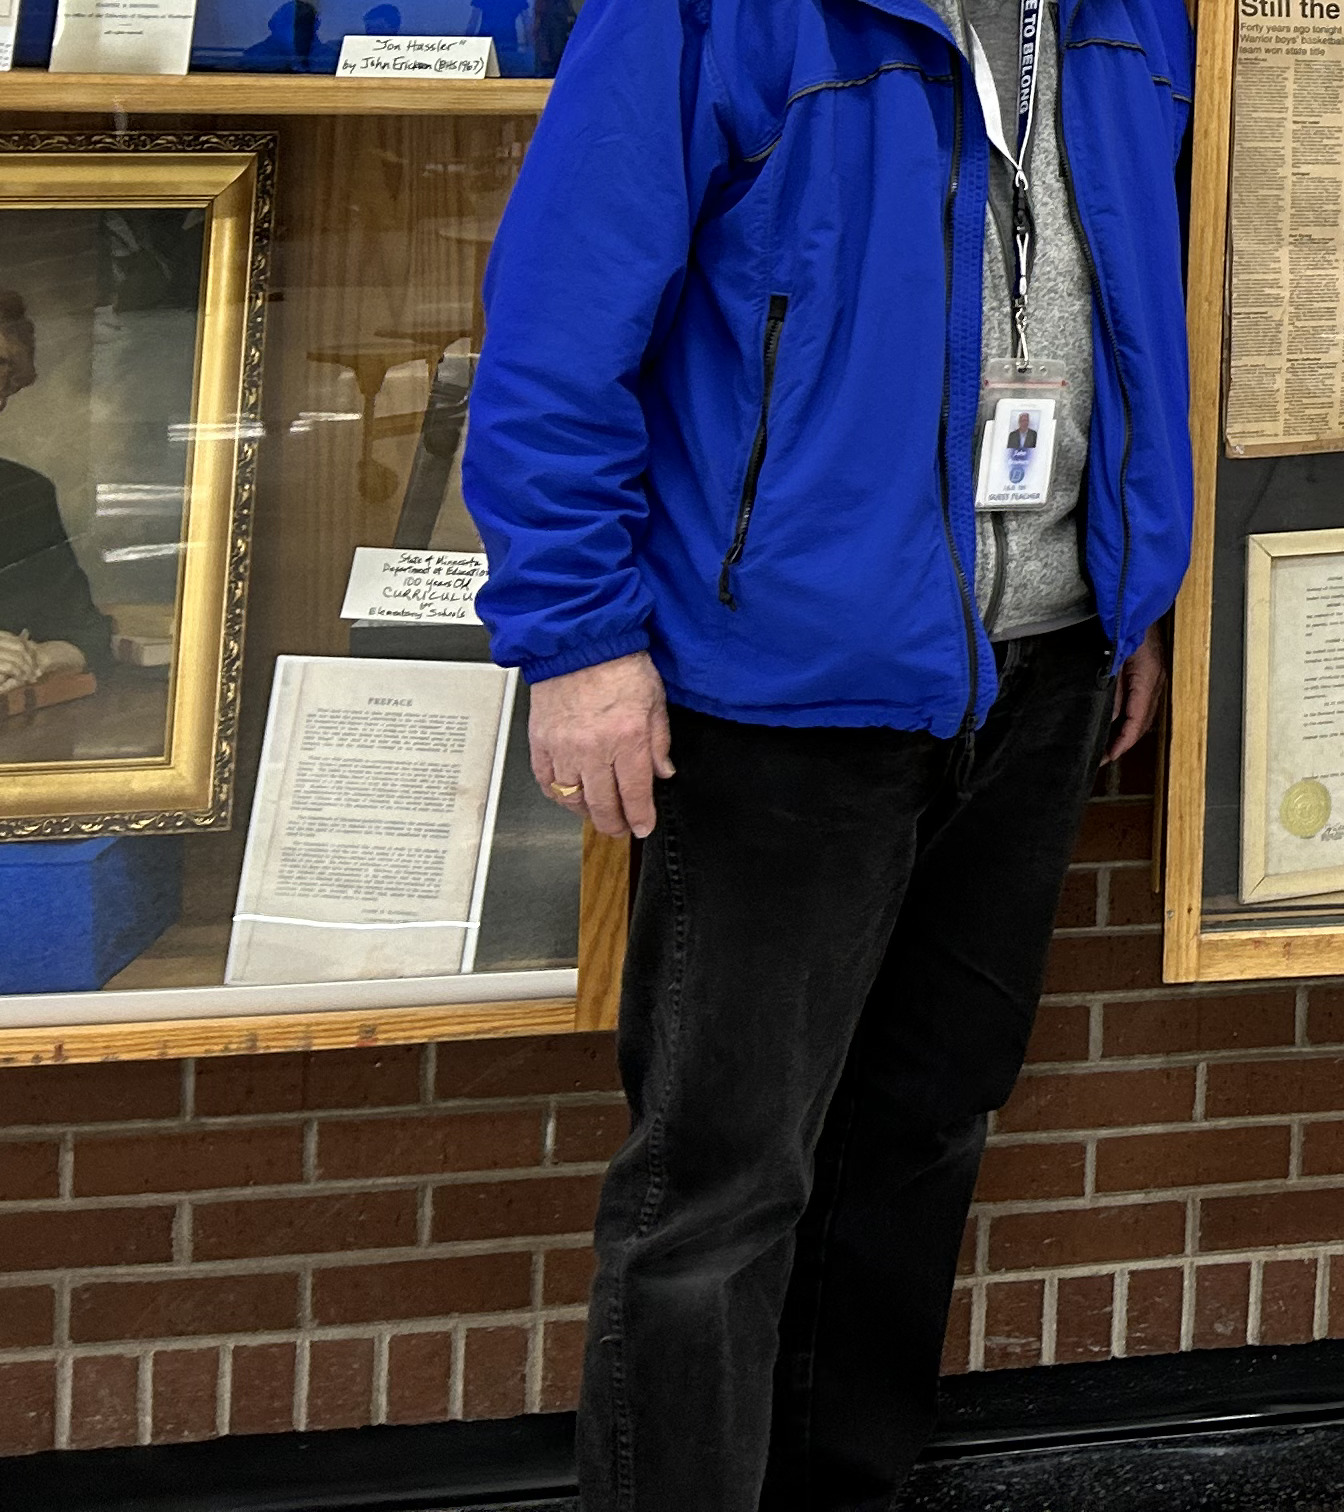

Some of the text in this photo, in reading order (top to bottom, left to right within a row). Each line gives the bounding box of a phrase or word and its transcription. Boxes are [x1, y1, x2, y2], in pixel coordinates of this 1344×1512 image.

[1022, 13, 1037, 39] TO
[1240, 22, 1343, 35] Forty years ago tonight
[1240, 34, 1273, 43] Warrior
[1239, 46, 1326, 56] team won state title
[342, 60, 357, 74] by
[360, 56, 390, 70] John
[1018, 43, 1035, 115] BELONG
[398, 552, 422, 564] State
[435, 553, 482, 566] Minnesota
[382, 563, 430, 577] Department
[402, 576, 473, 592] 100 Old
[382, 586, 474, 601] CURRICULU
[368, 607, 466, 619] Elementary Schools
[367, 697, 413, 708] PREFACE
